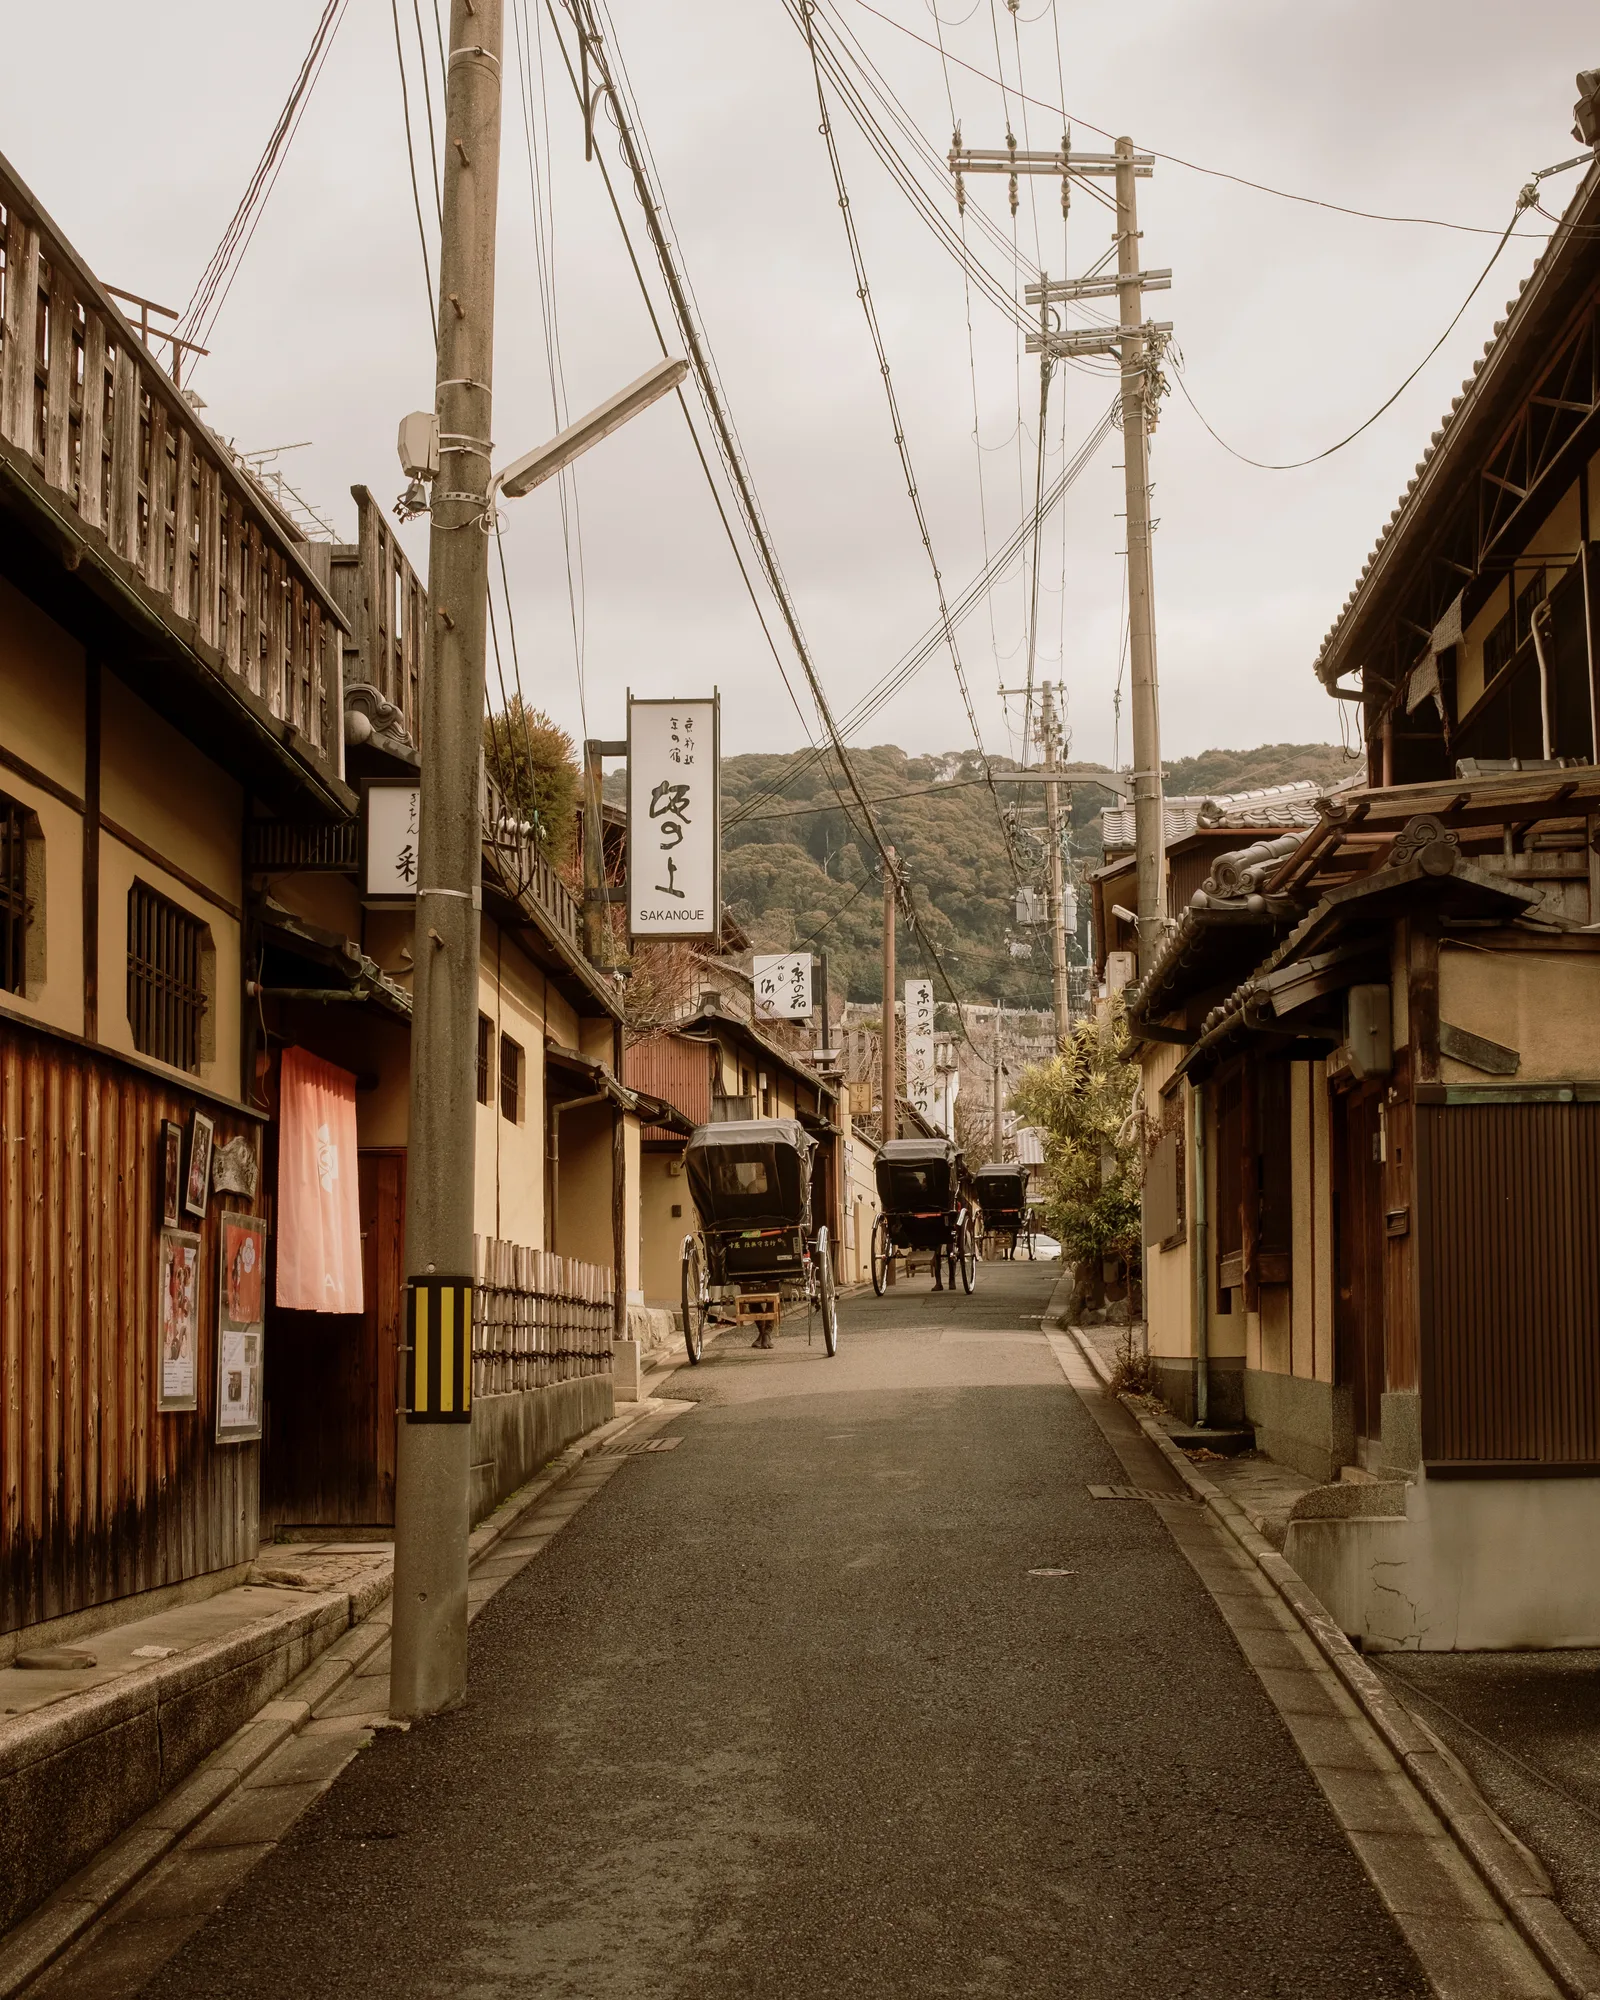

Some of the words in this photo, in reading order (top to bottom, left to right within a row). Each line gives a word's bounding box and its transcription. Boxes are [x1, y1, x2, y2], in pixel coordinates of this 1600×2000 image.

[668, 717, 681, 763] 京の宿
[683, 717, 695, 765] 京料理
[649, 780, 692, 899] 坂の上
[639, 909, 704, 921] SAKANOUE
[790, 962, 807, 1010] 京の宿
[916, 984, 931, 1036] 京の宿
